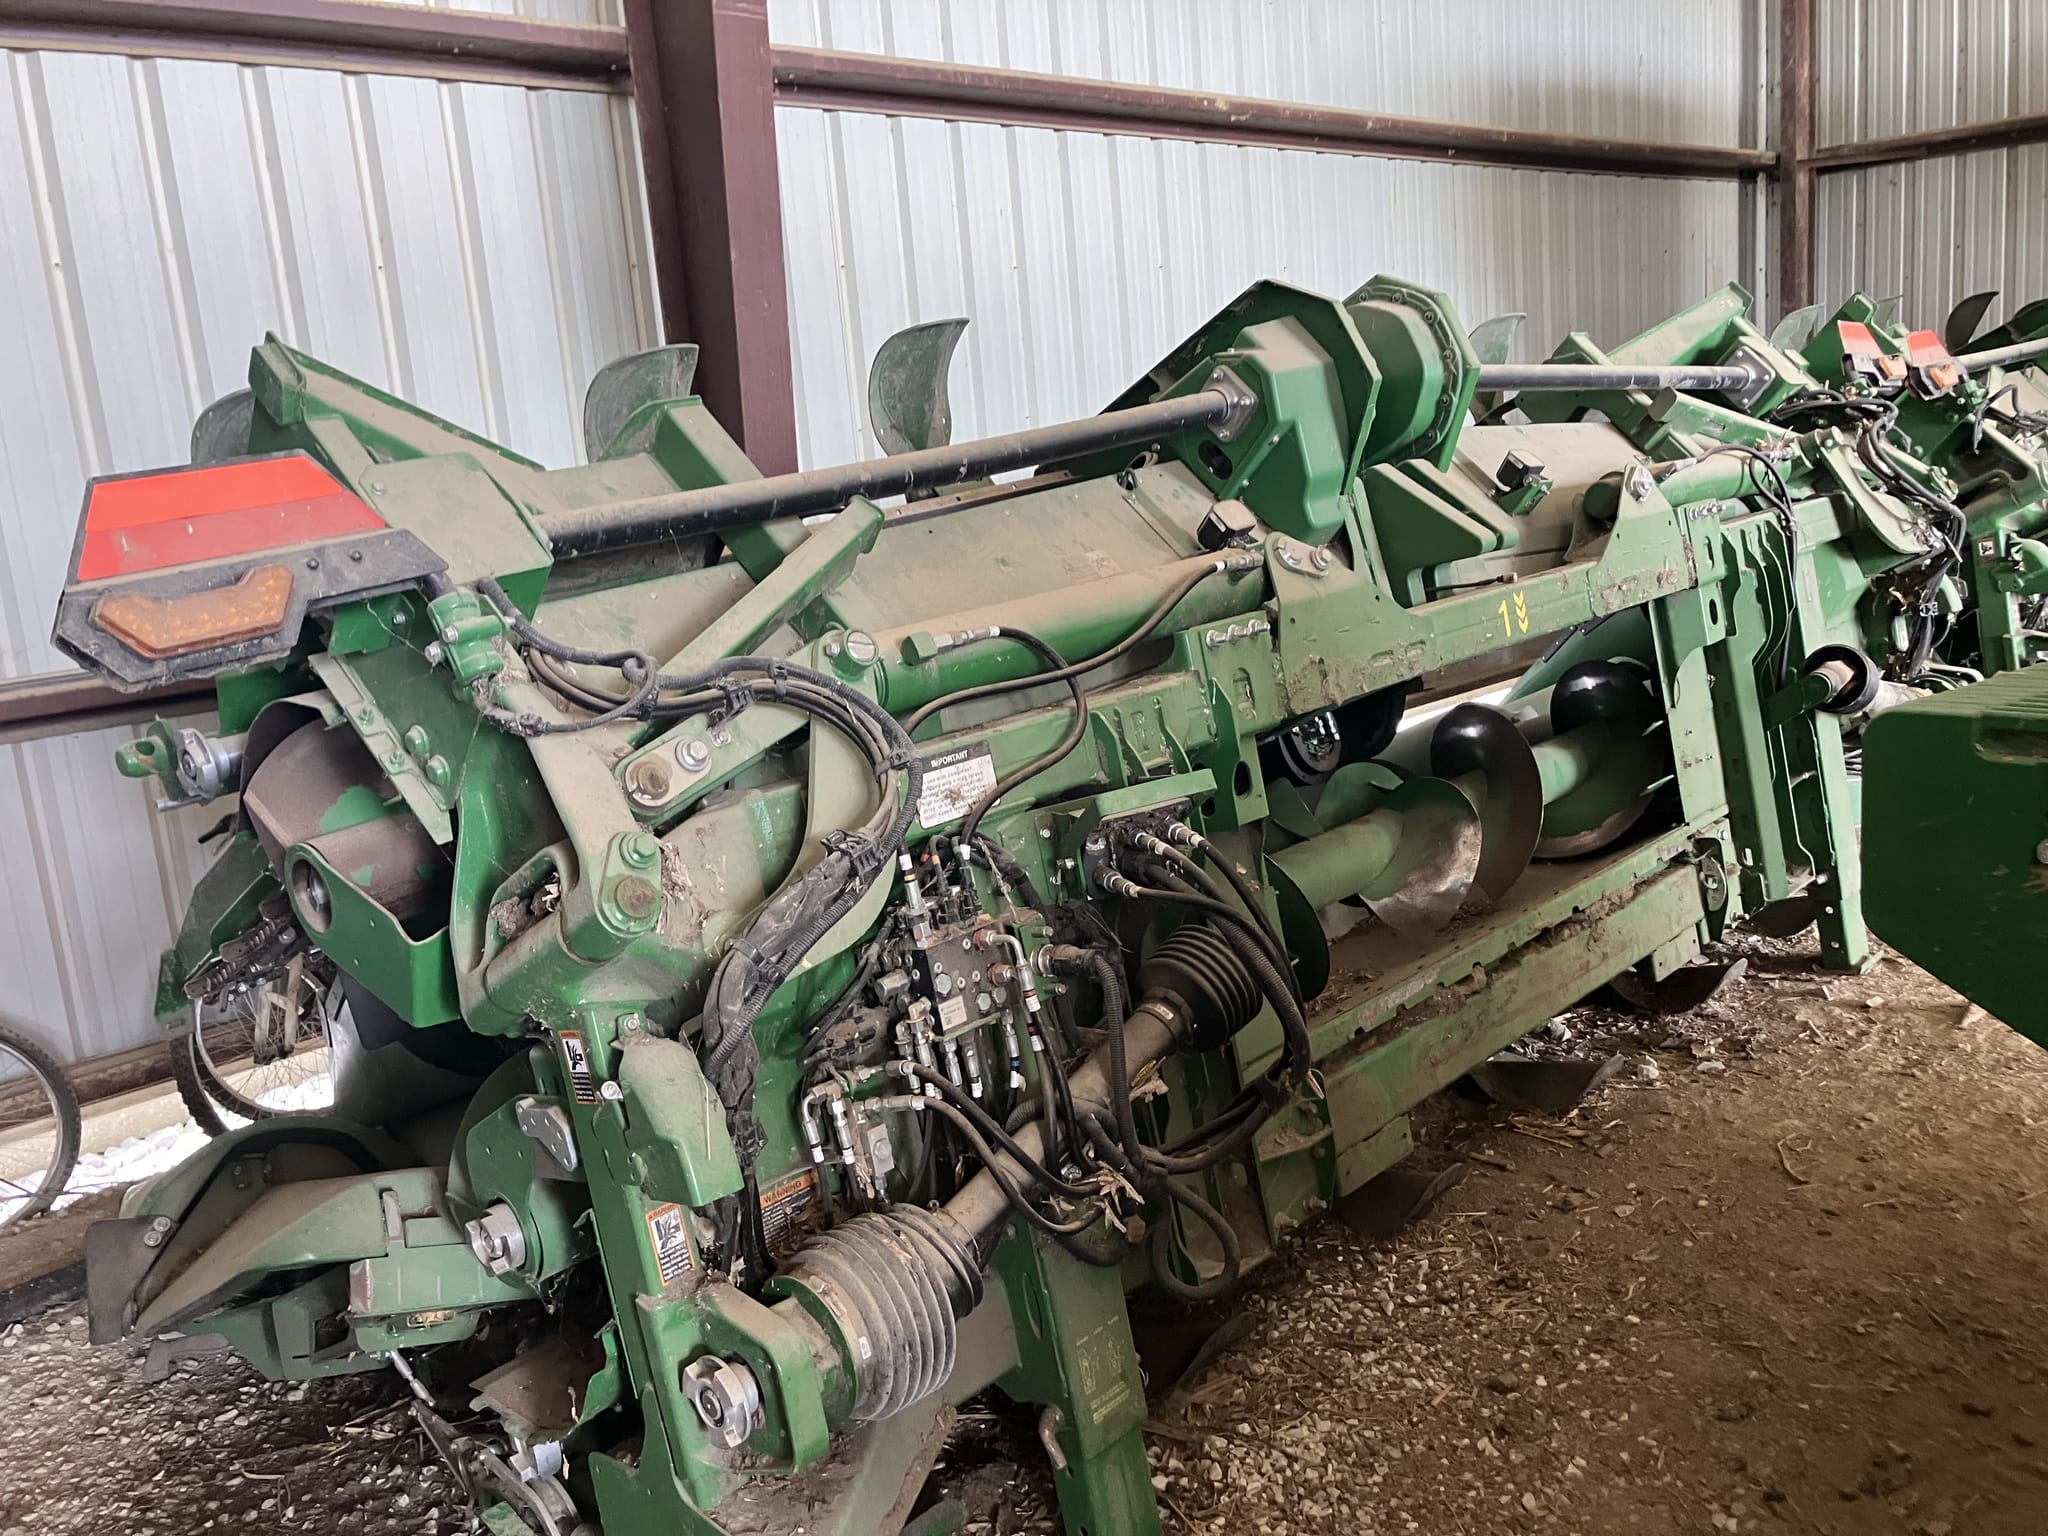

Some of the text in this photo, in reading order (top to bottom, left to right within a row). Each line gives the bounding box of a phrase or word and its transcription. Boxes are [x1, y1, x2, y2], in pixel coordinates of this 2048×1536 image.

[1498, 599, 1511, 637] 1
[930, 749, 968, 768] IMPORTANT
[763, 1180, 802, 1204] WARNING
